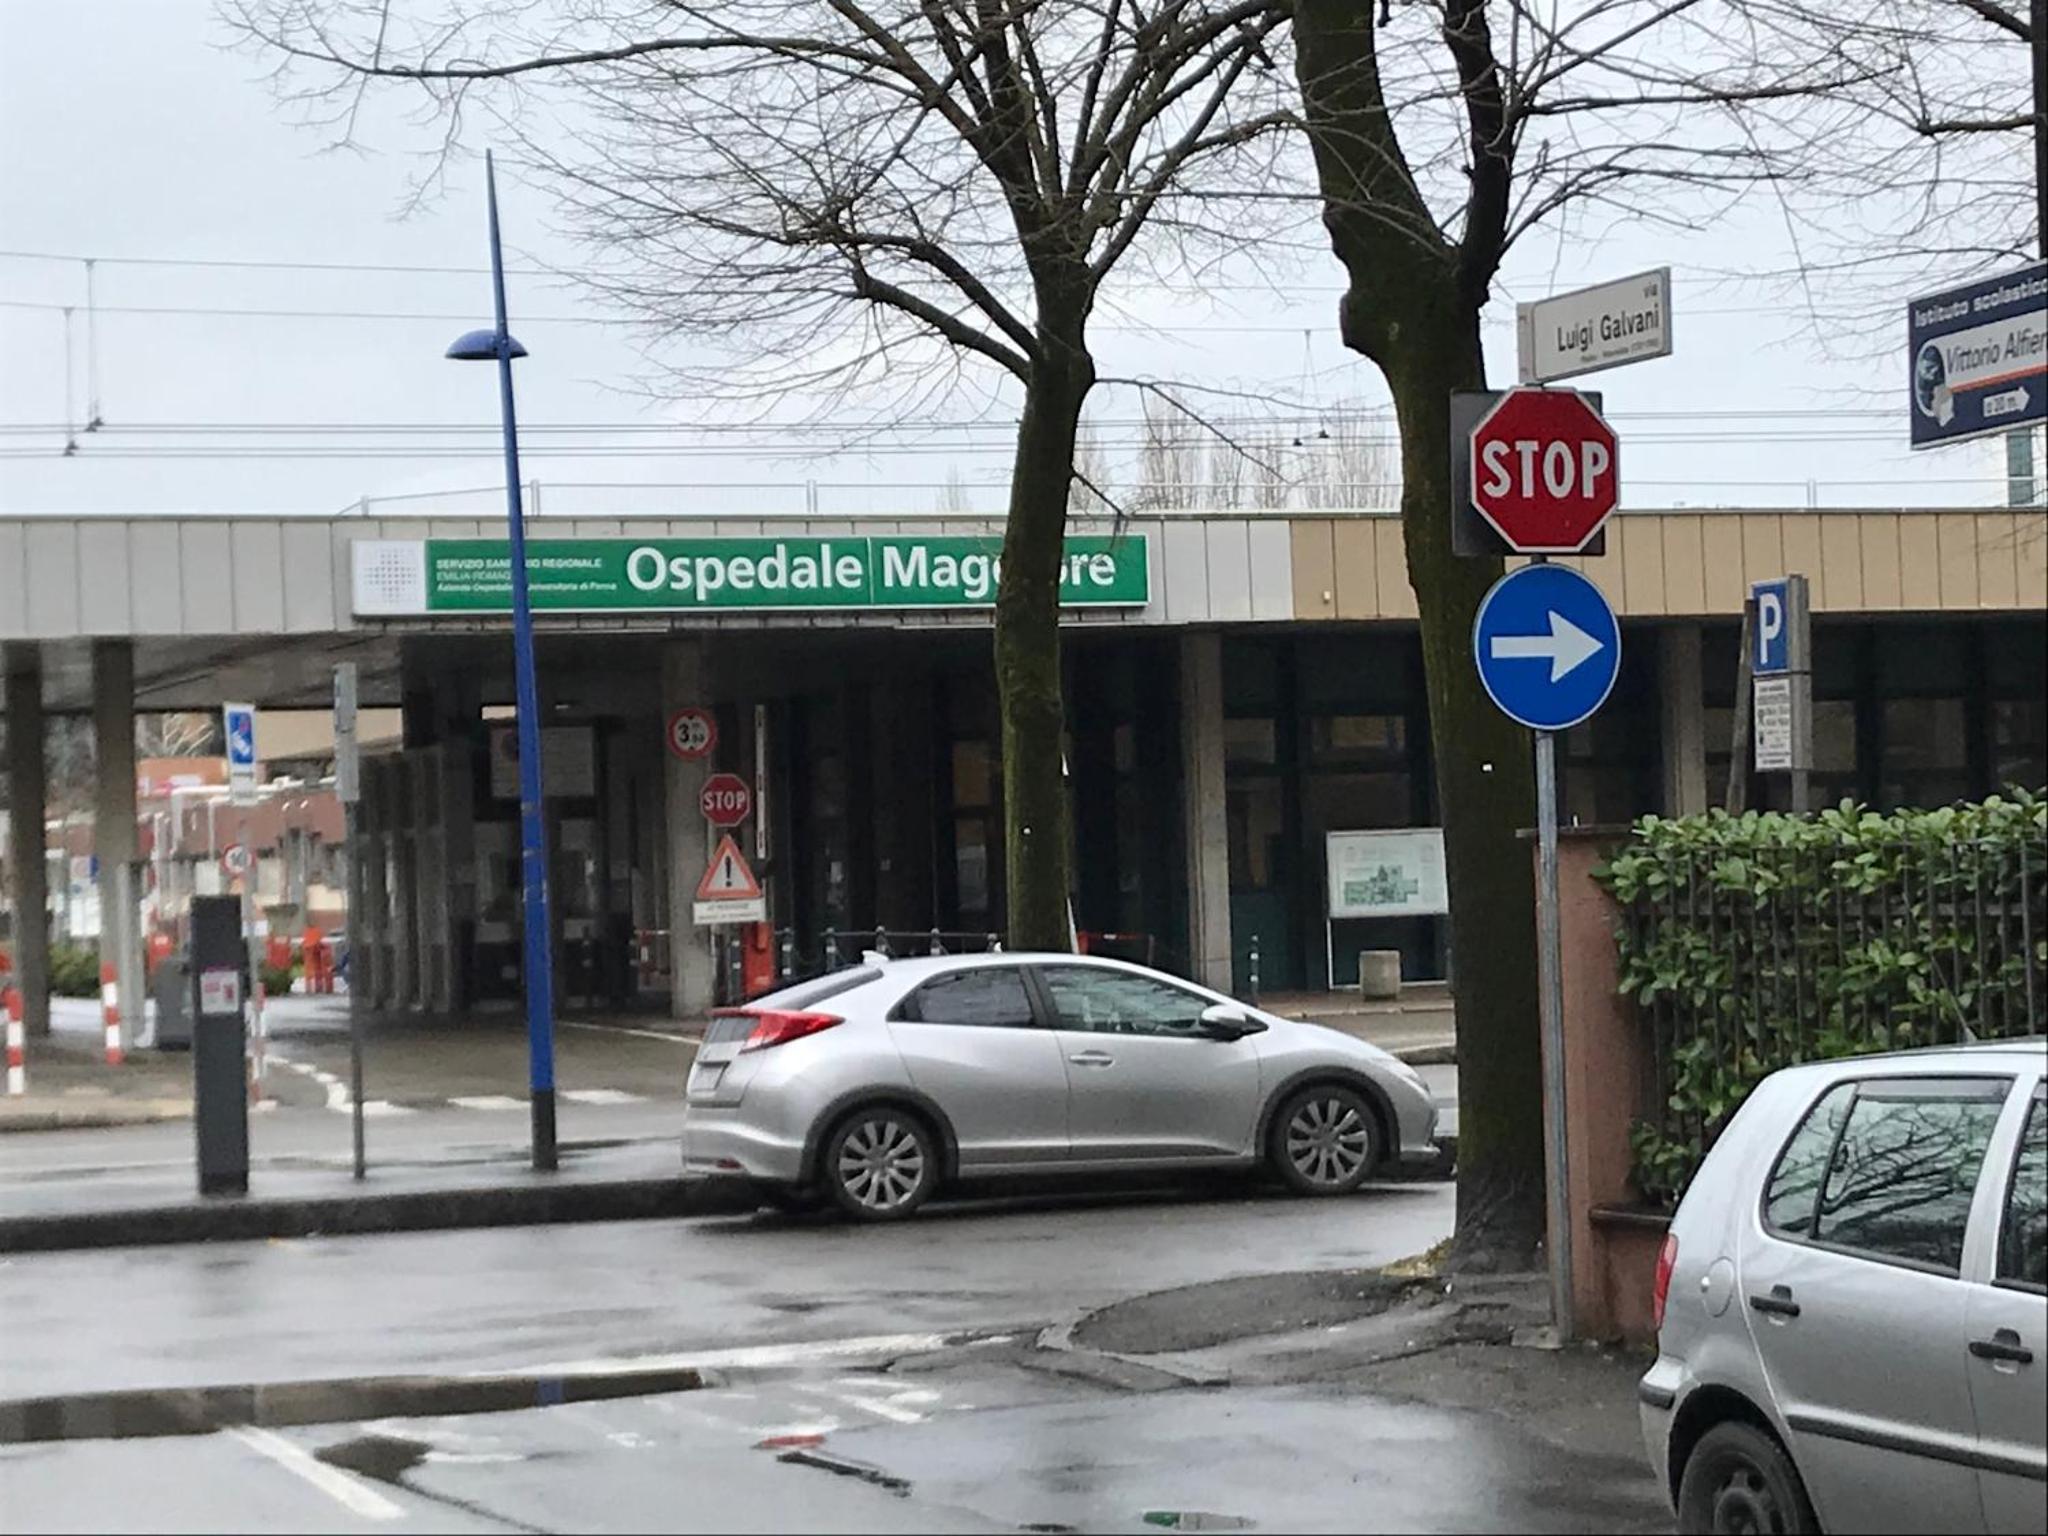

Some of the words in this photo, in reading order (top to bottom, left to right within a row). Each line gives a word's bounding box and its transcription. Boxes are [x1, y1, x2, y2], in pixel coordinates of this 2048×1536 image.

[1557, 319, 1594, 352] Luigi
[1600, 304, 1660, 342] Galvani
[1915, 299, 1969, 328] Istituto
[1946, 338, 2000, 374] Vittorio
[1482, 440, 1609, 498] STOP
[626, 543, 864, 602] Ospedale
[883, 545, 1116, 599] Magre
[1760, 592, 1782, 665] P
[704, 791, 746, 811] STOP
